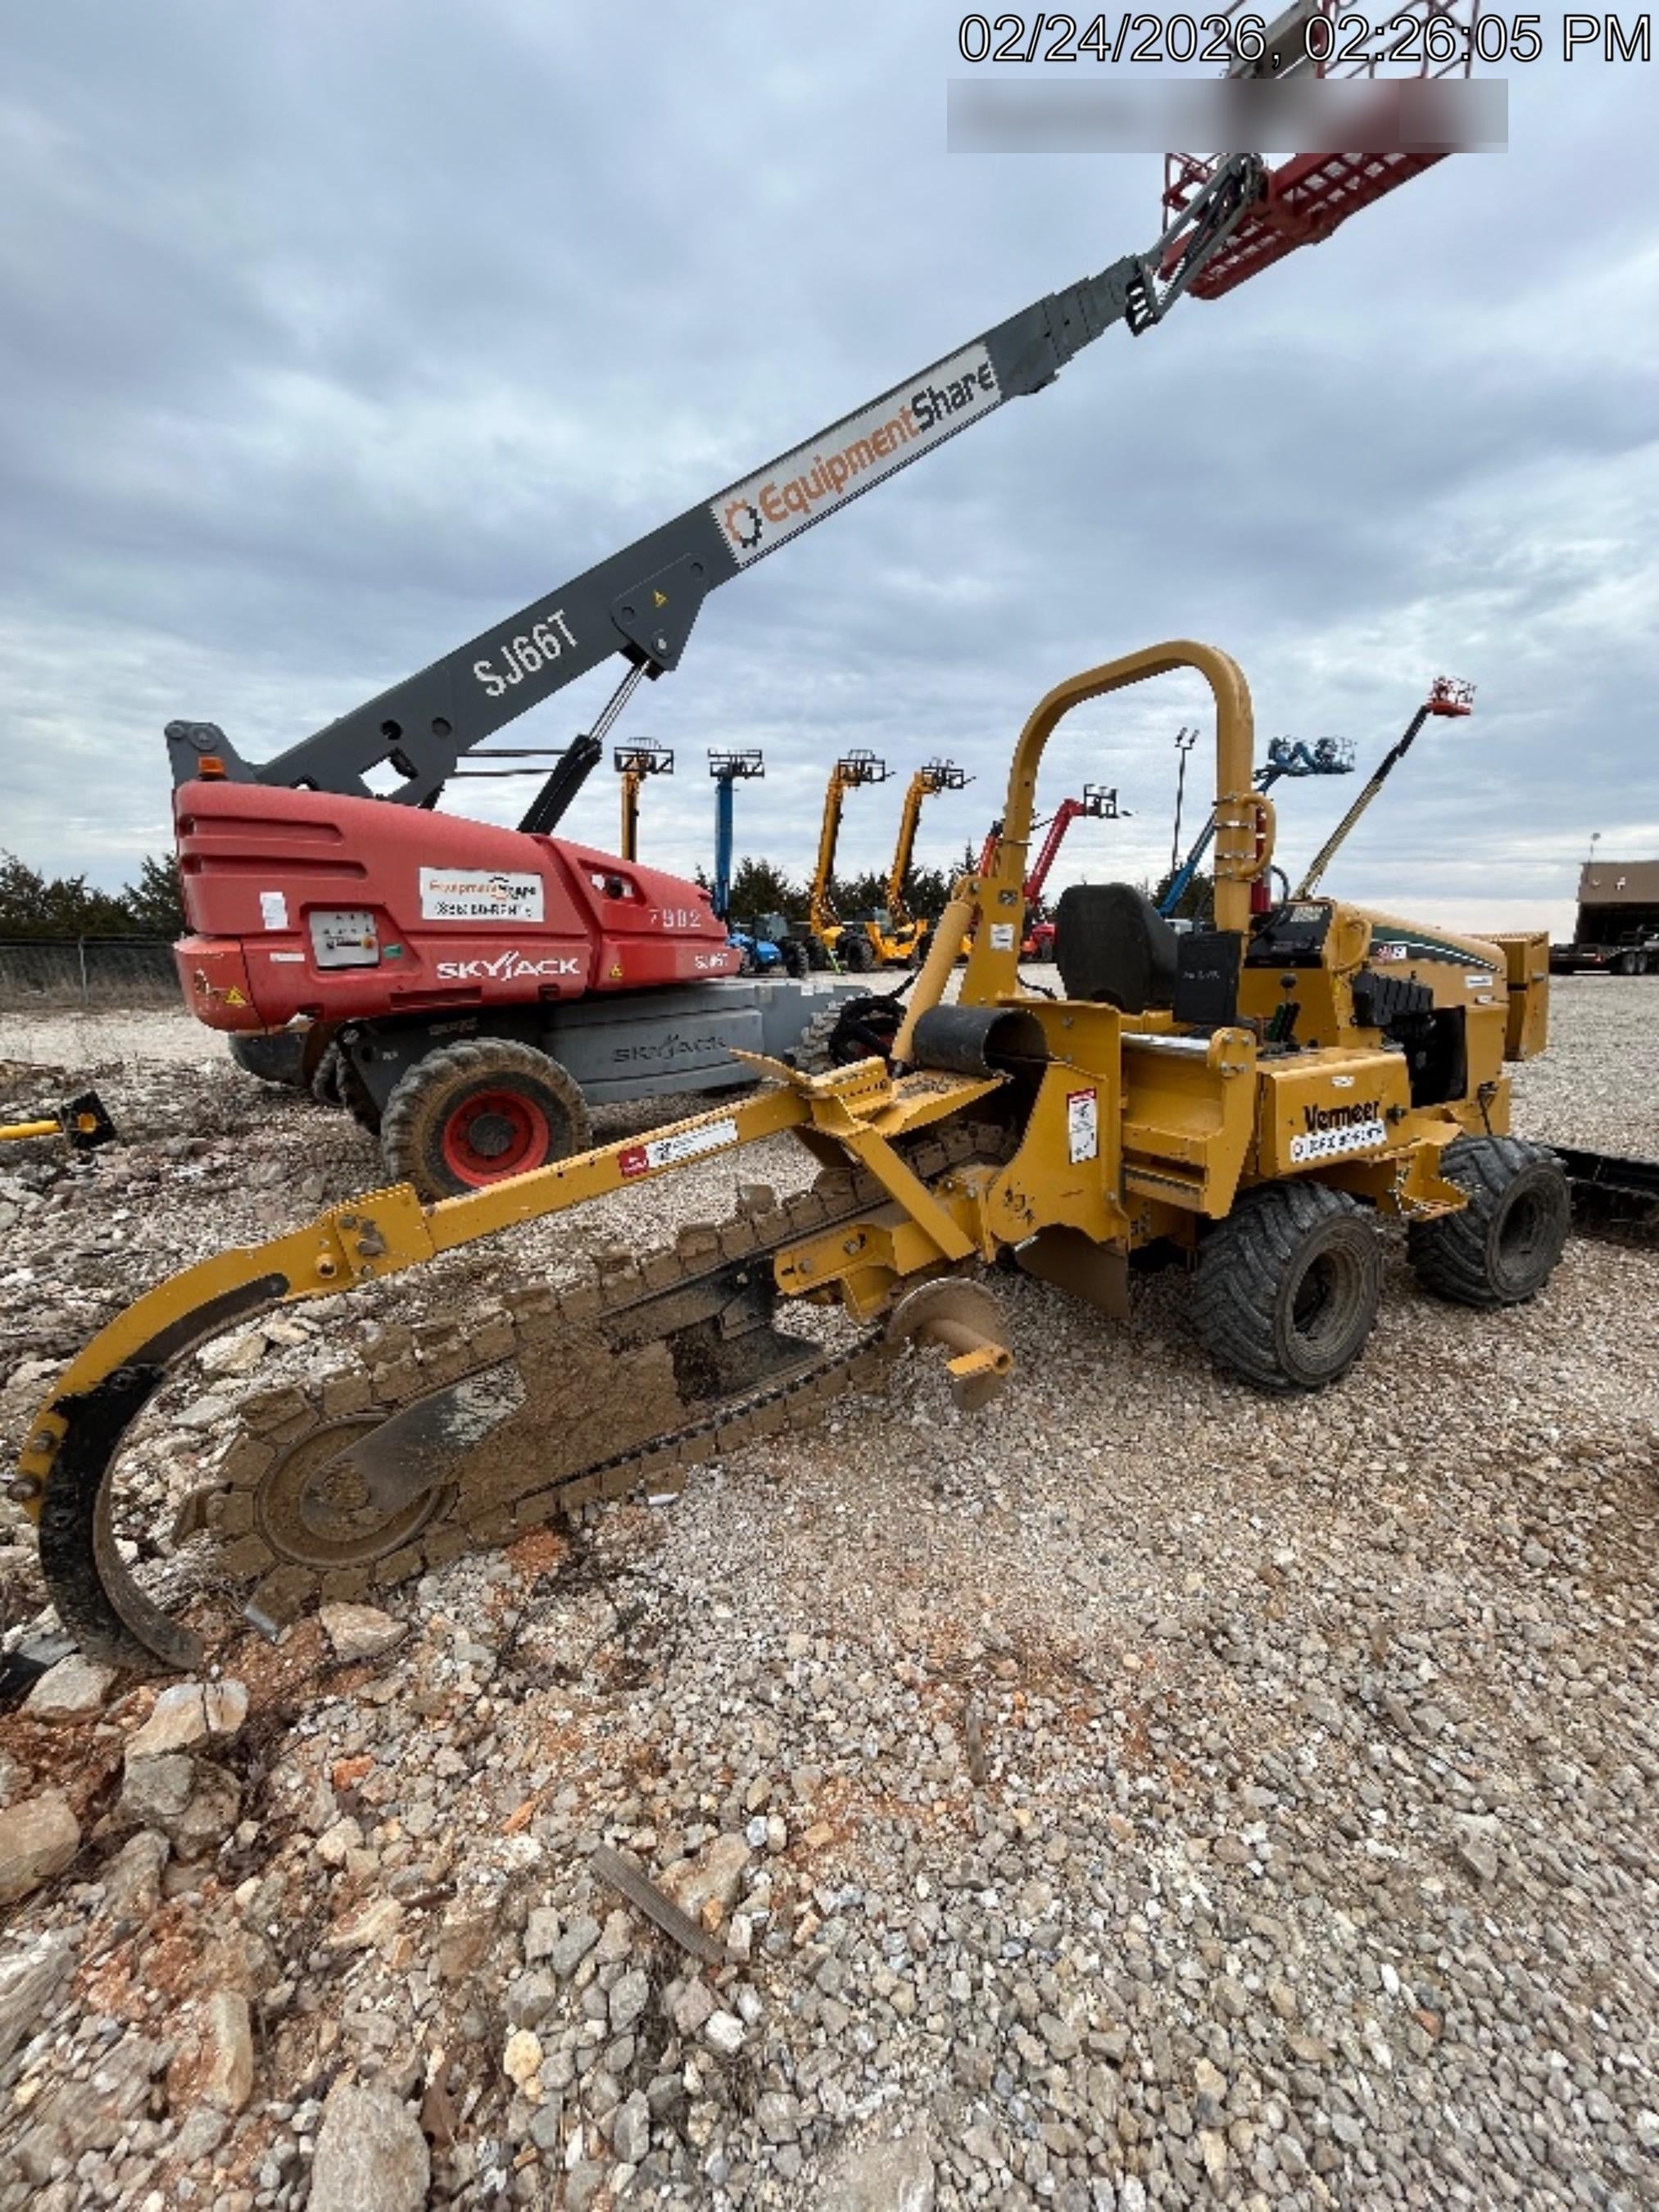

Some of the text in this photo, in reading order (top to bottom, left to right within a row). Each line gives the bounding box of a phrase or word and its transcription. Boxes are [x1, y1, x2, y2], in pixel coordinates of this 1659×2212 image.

[758, 360, 995, 524] EquipmentShare
[473, 609, 578, 696] SJ66T
[437, 950, 581, 981] SKYJACK
[1303, 1100, 1380, 1131] Vermeer
